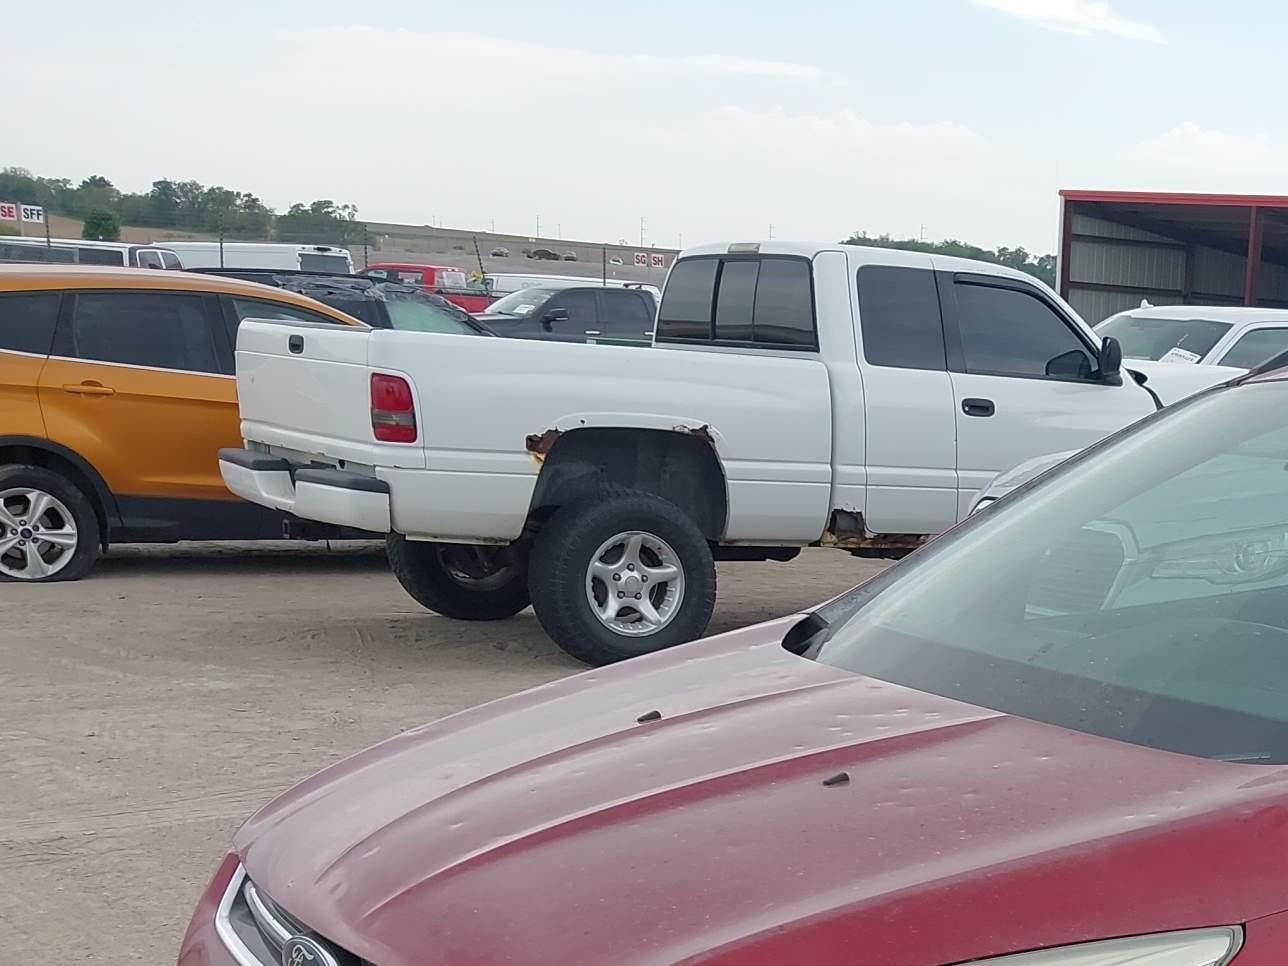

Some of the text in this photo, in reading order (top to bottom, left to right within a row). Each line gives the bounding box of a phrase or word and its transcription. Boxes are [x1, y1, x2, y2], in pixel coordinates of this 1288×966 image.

[0, 205, 15, 218] SE
[22, 207, 43, 220] SFF
[635, 254, 646, 264] SG
[652, 256, 663, 266] SH
